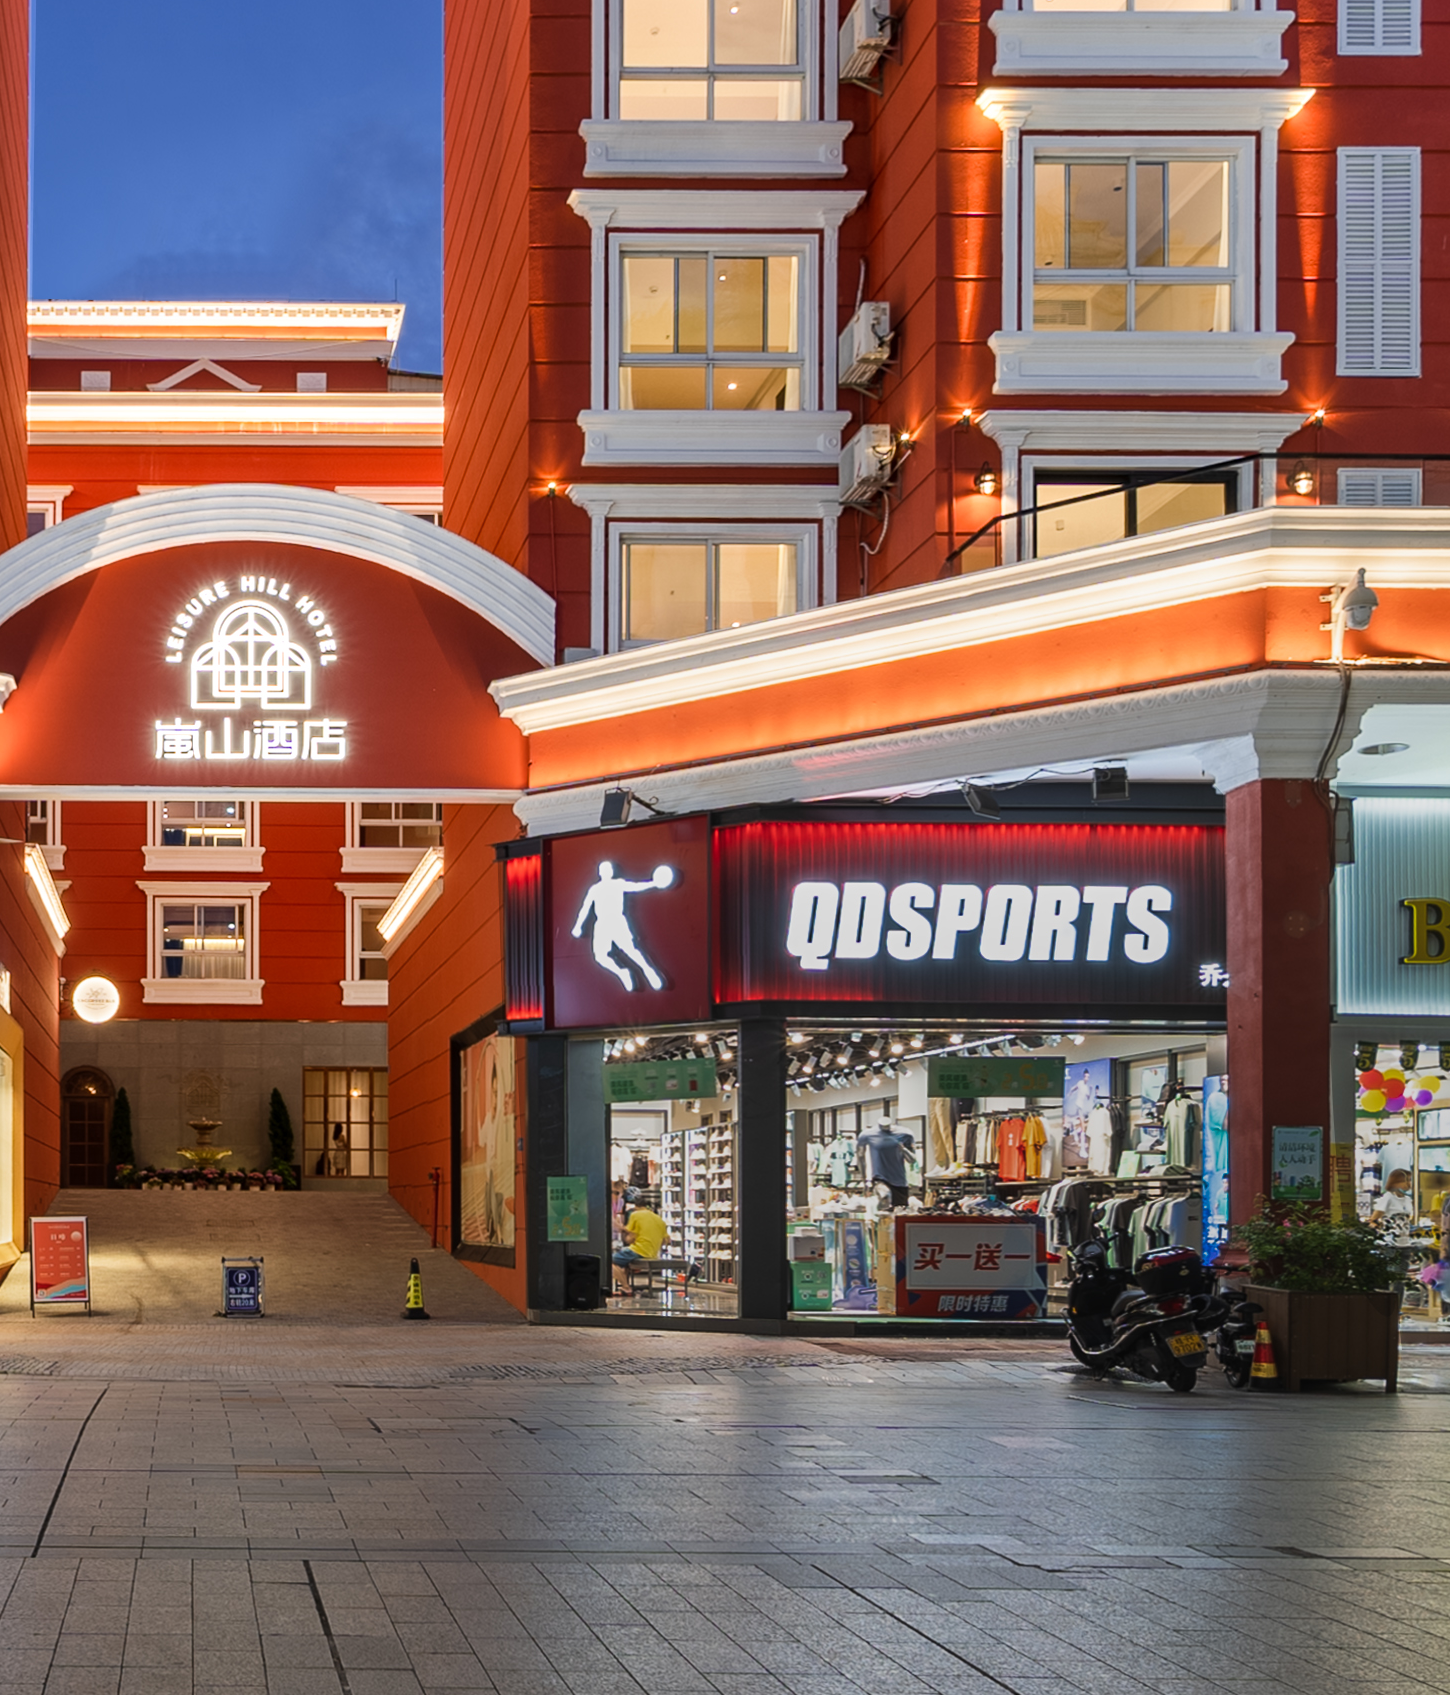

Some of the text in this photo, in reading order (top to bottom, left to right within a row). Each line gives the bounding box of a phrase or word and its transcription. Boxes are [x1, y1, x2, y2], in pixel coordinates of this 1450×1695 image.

[165, 575, 337, 666] LEISURE HILL HOTEL
[786, 881, 1173, 971] QDSPORTS
[1199, 963, 1230, 988] 乔
[913, 1242, 1032, 1272] 买一送一
[937, 1295, 1009, 1312] 限时特惠
